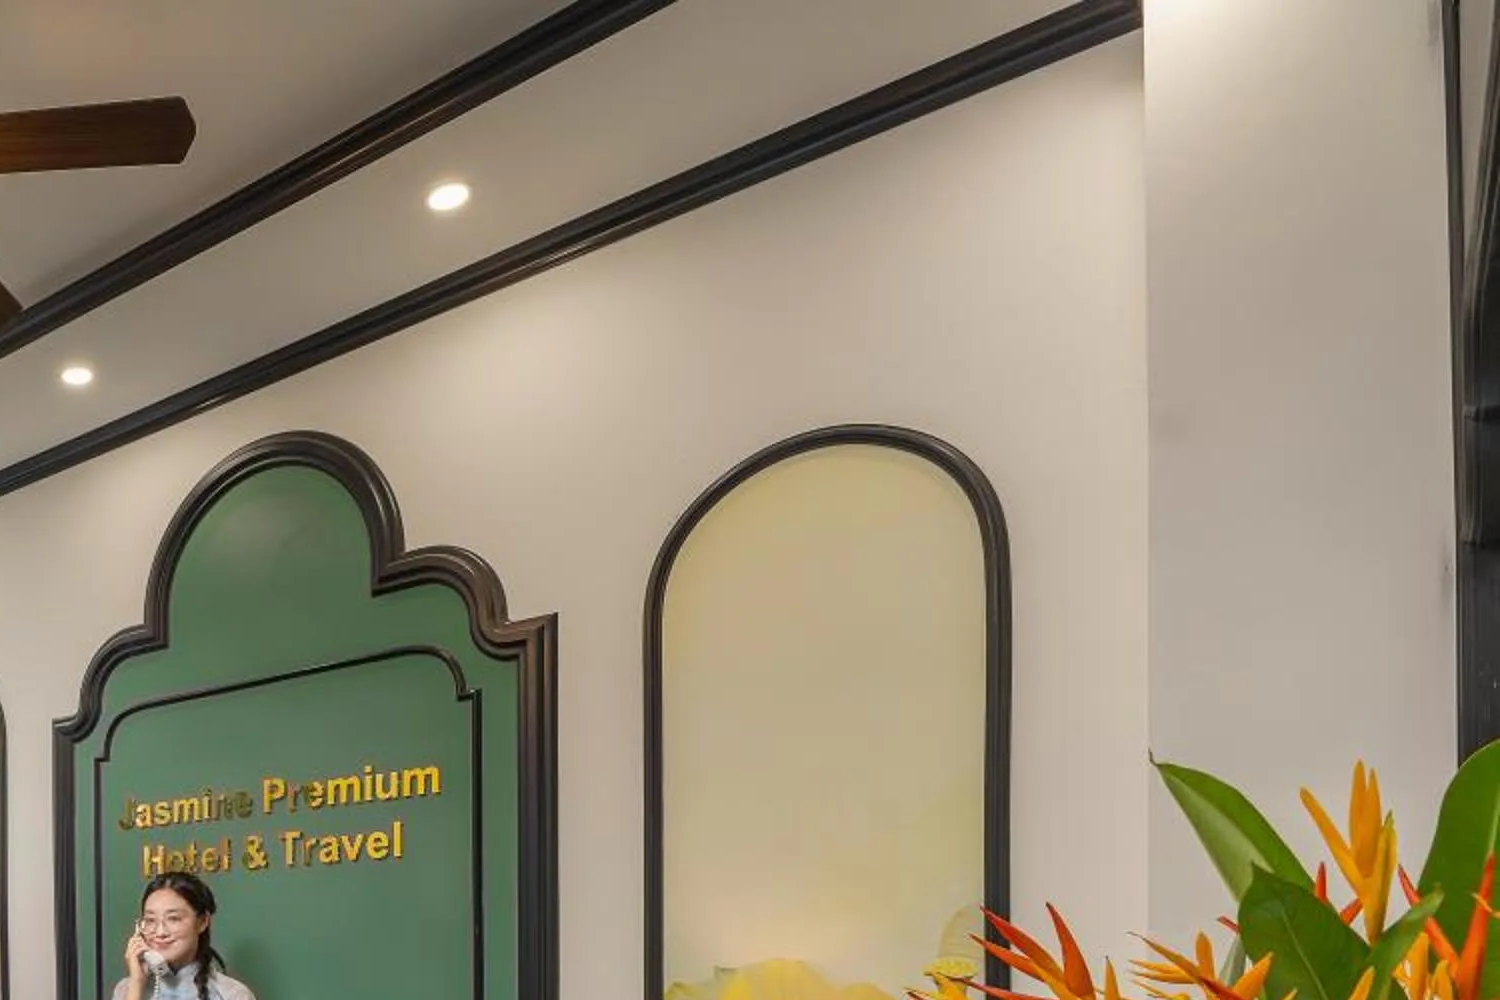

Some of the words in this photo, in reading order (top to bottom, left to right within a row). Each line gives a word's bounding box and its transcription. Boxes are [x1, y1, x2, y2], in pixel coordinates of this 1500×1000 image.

[118, 788, 254, 830] Jasmine
[262, 764, 442, 814] Premium
[141, 837, 232, 879] Hotel
[241, 832, 269, 871] &
[279, 818, 405, 867] Travel
